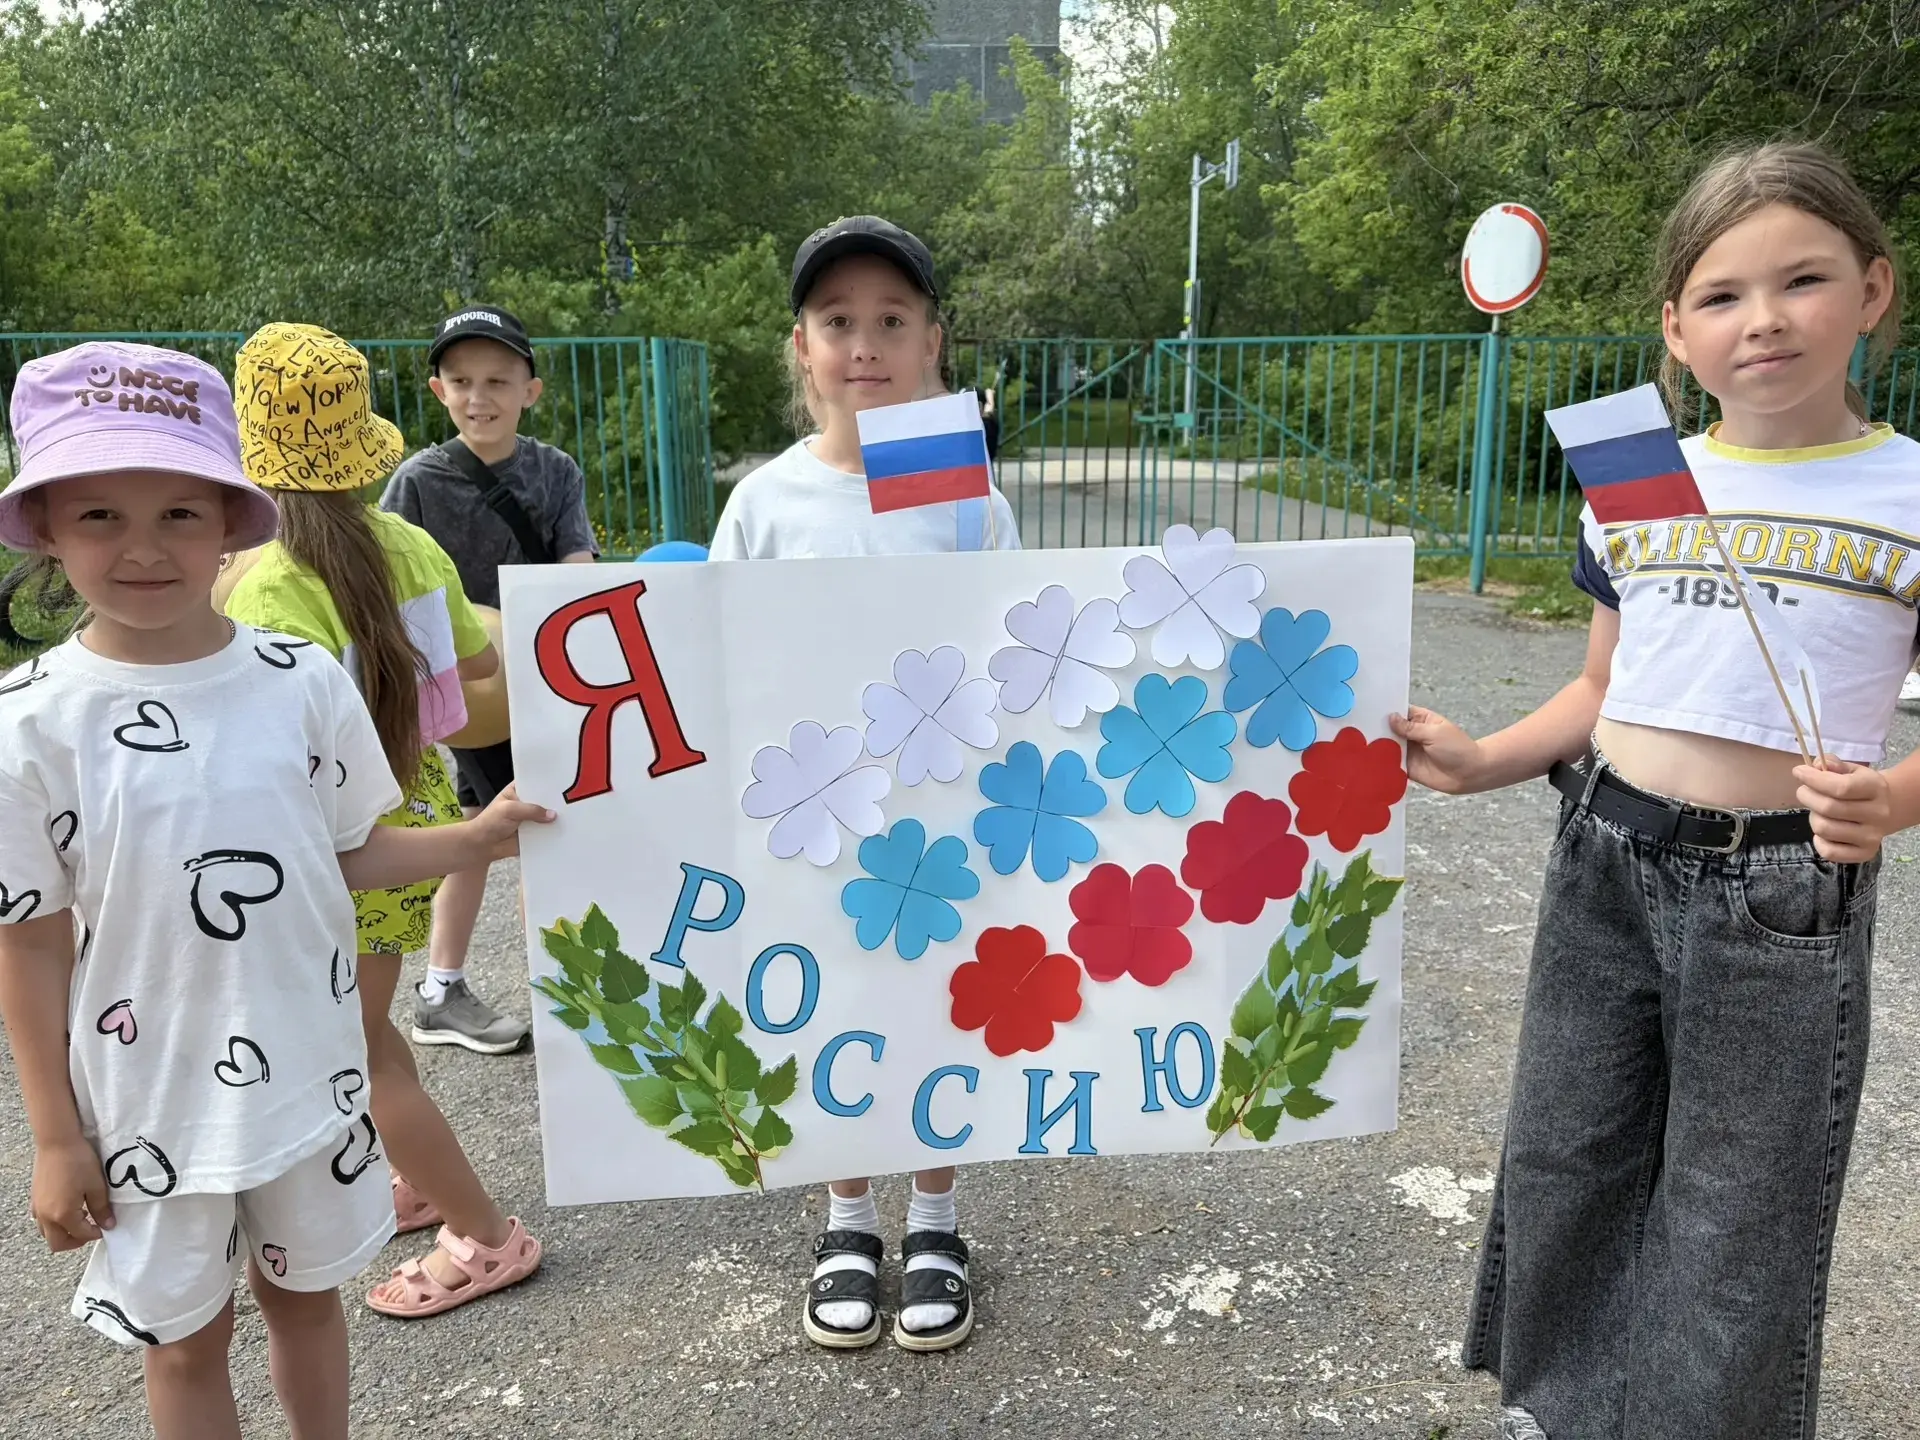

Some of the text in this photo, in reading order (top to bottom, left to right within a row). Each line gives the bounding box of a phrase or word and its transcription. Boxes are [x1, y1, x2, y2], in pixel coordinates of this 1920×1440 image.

[74, 388, 114, 407] TO
[118, 366, 200, 403] NICE
[118, 392, 202, 425] HAVE
[271, 440, 340, 491] TOKYO
[534, 579, 707, 803] Я
[650, 862, 1216, 1156] РОССИЮ
